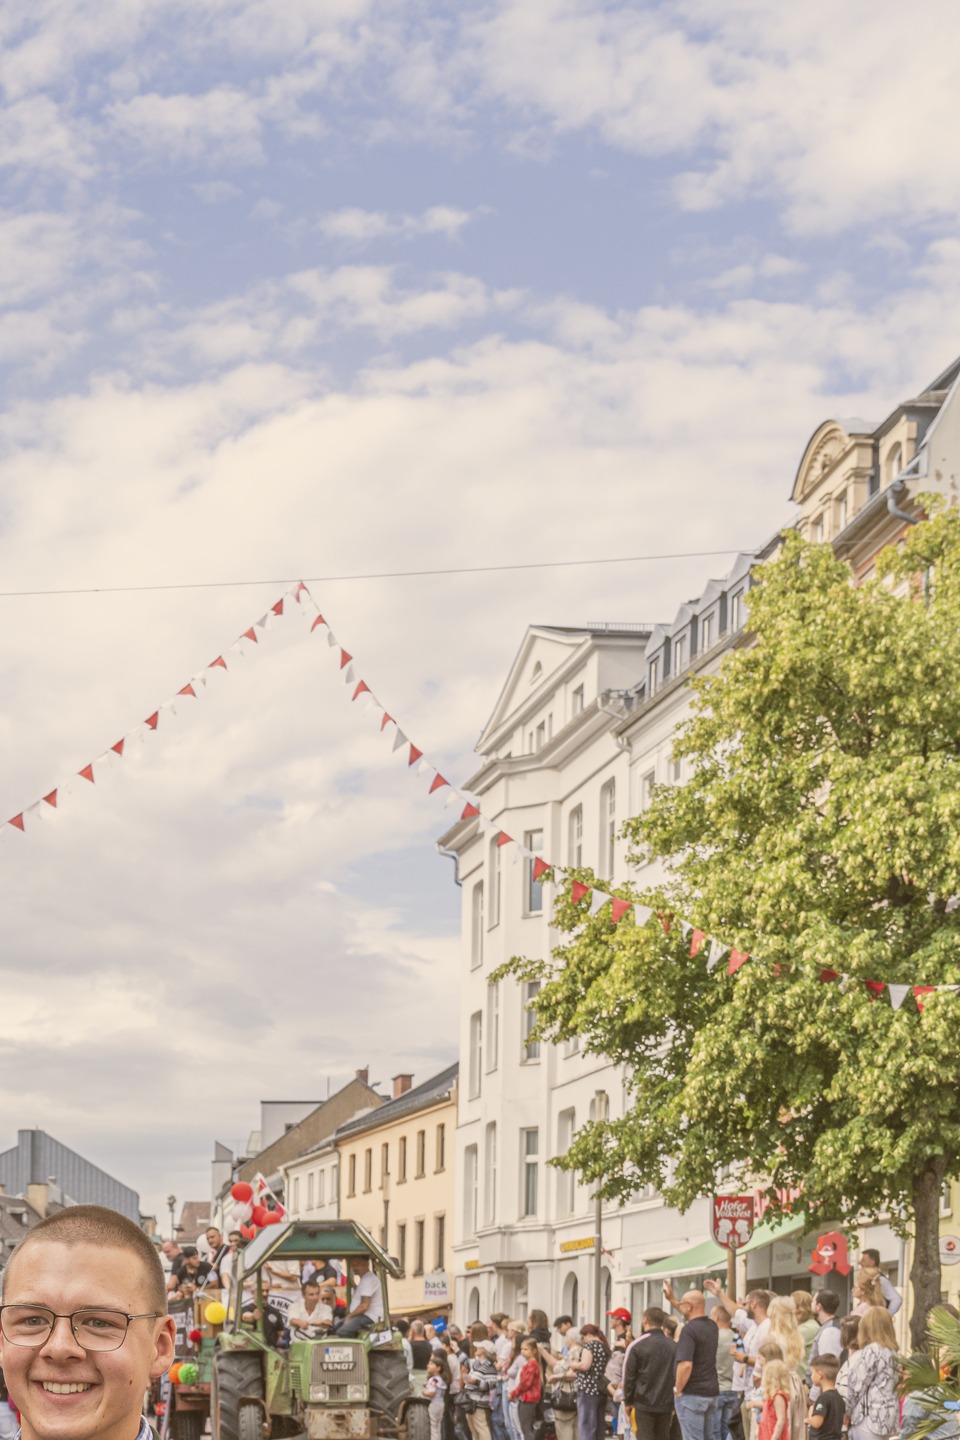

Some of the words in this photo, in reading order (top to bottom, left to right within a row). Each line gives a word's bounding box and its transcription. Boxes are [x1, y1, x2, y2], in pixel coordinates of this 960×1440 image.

[720, 1200, 748, 1211] Hofer
[715, 1205, 752, 1218] Volksfest
[425, 1280, 447, 1289] back
